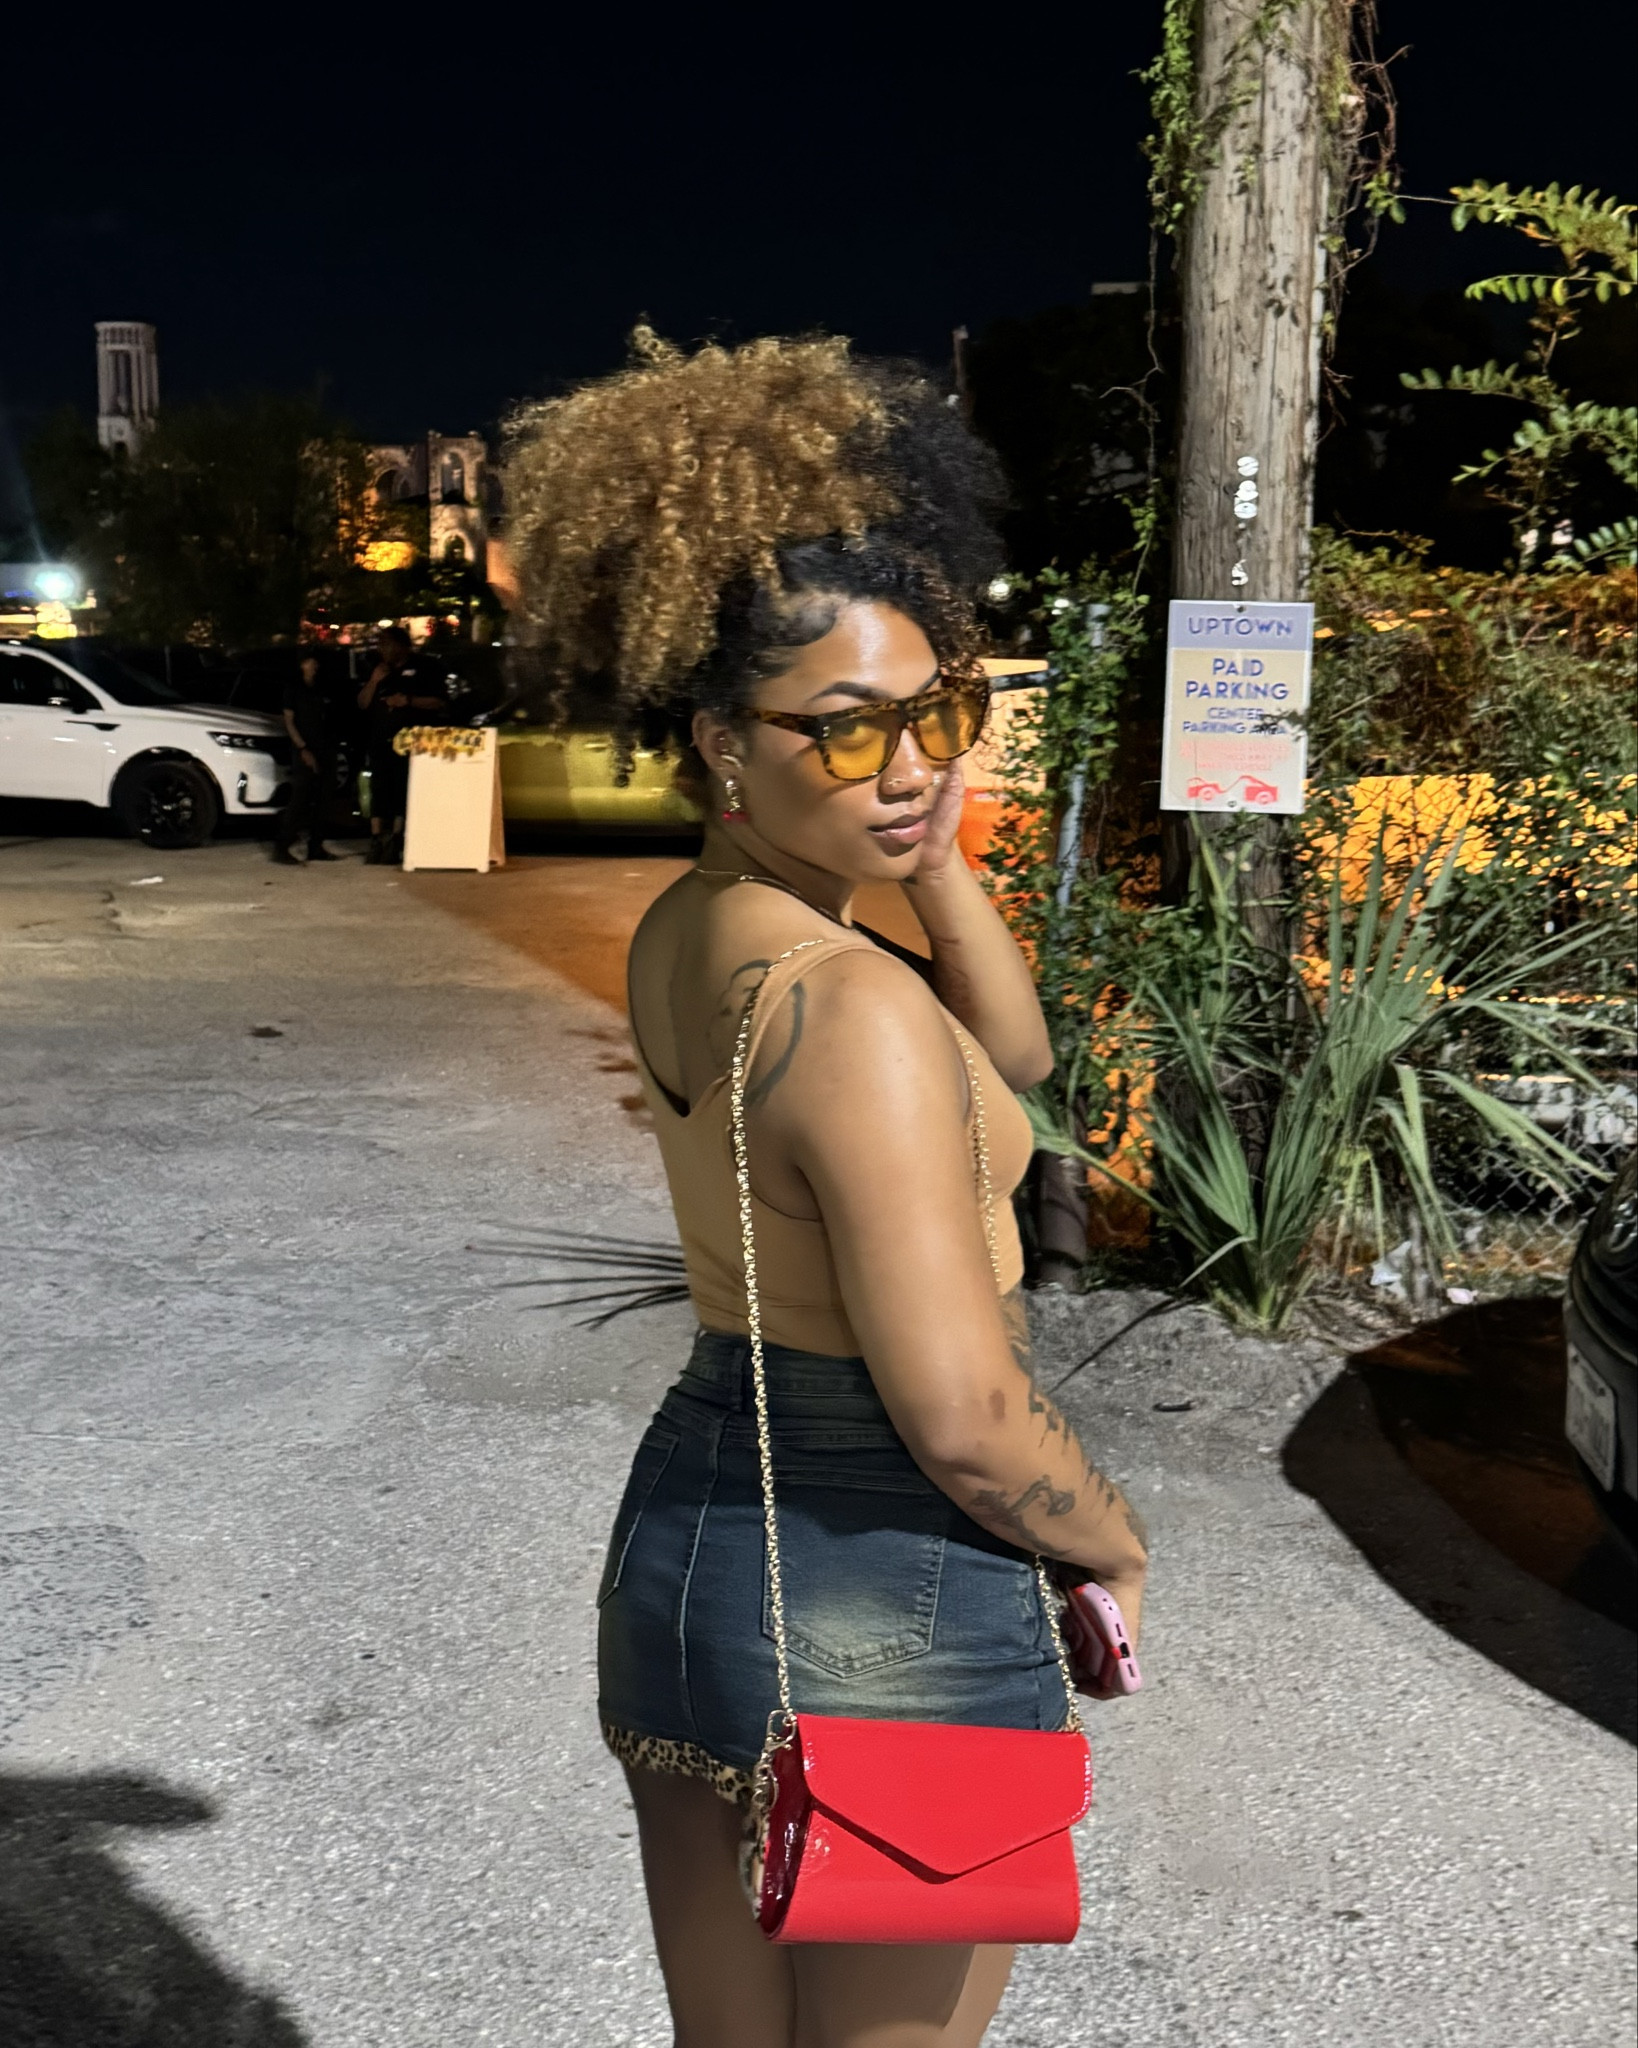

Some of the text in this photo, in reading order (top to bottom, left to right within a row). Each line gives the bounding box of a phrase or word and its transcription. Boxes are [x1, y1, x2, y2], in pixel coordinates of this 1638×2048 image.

[1188, 617, 1292, 636] UPTOWN
[1212, 658, 1264, 677] PAID
[1185, 681, 1289, 700] PARKING
[1183, 721, 1287, 734] PARKING AA
